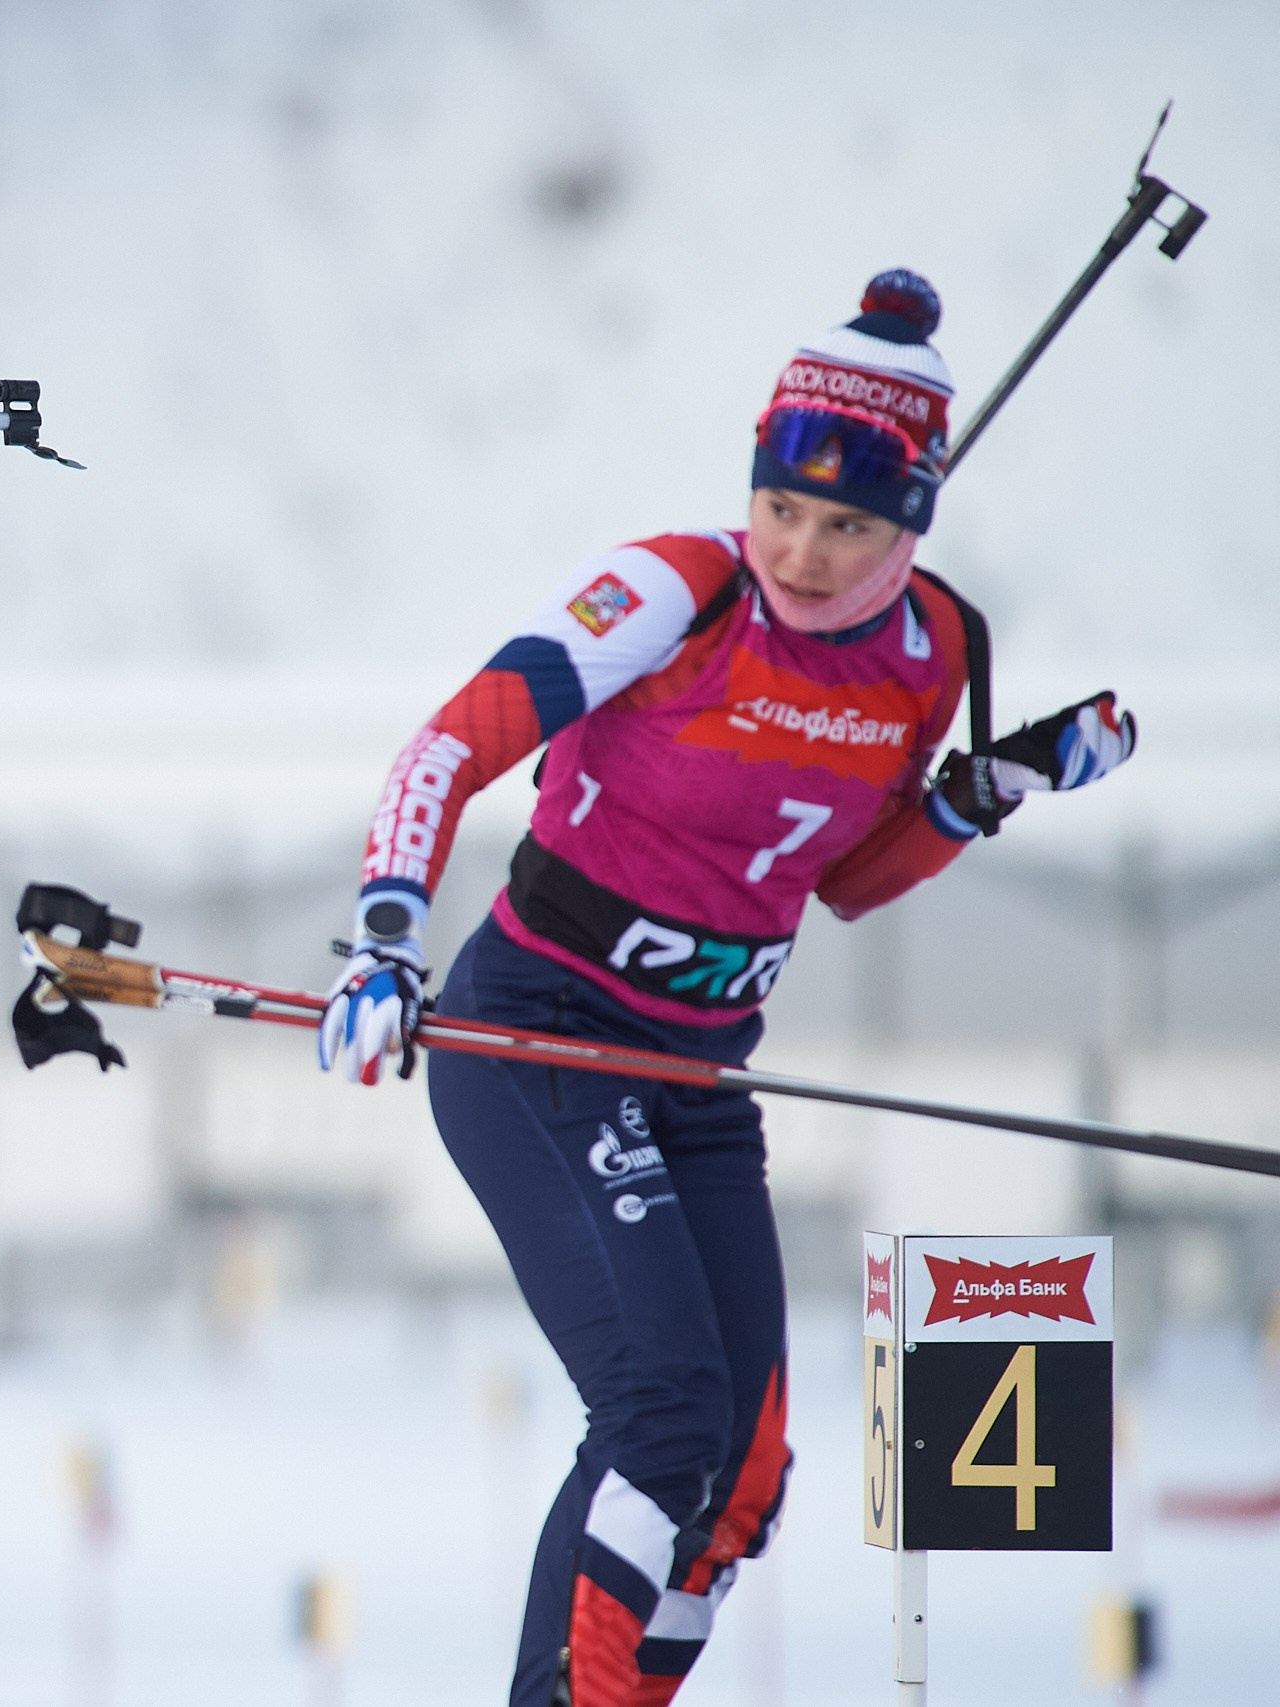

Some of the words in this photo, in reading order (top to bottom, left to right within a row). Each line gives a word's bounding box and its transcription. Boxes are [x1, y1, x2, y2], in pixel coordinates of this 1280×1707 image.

[569, 770, 602, 827] 7
[746, 797, 834, 883] 7
[953, 1279, 1016, 1300] Альфа
[1019, 1279, 1067, 1296] Банк
[872, 1345, 886, 1529] 5
[951, 1345, 1056, 1530] 4
